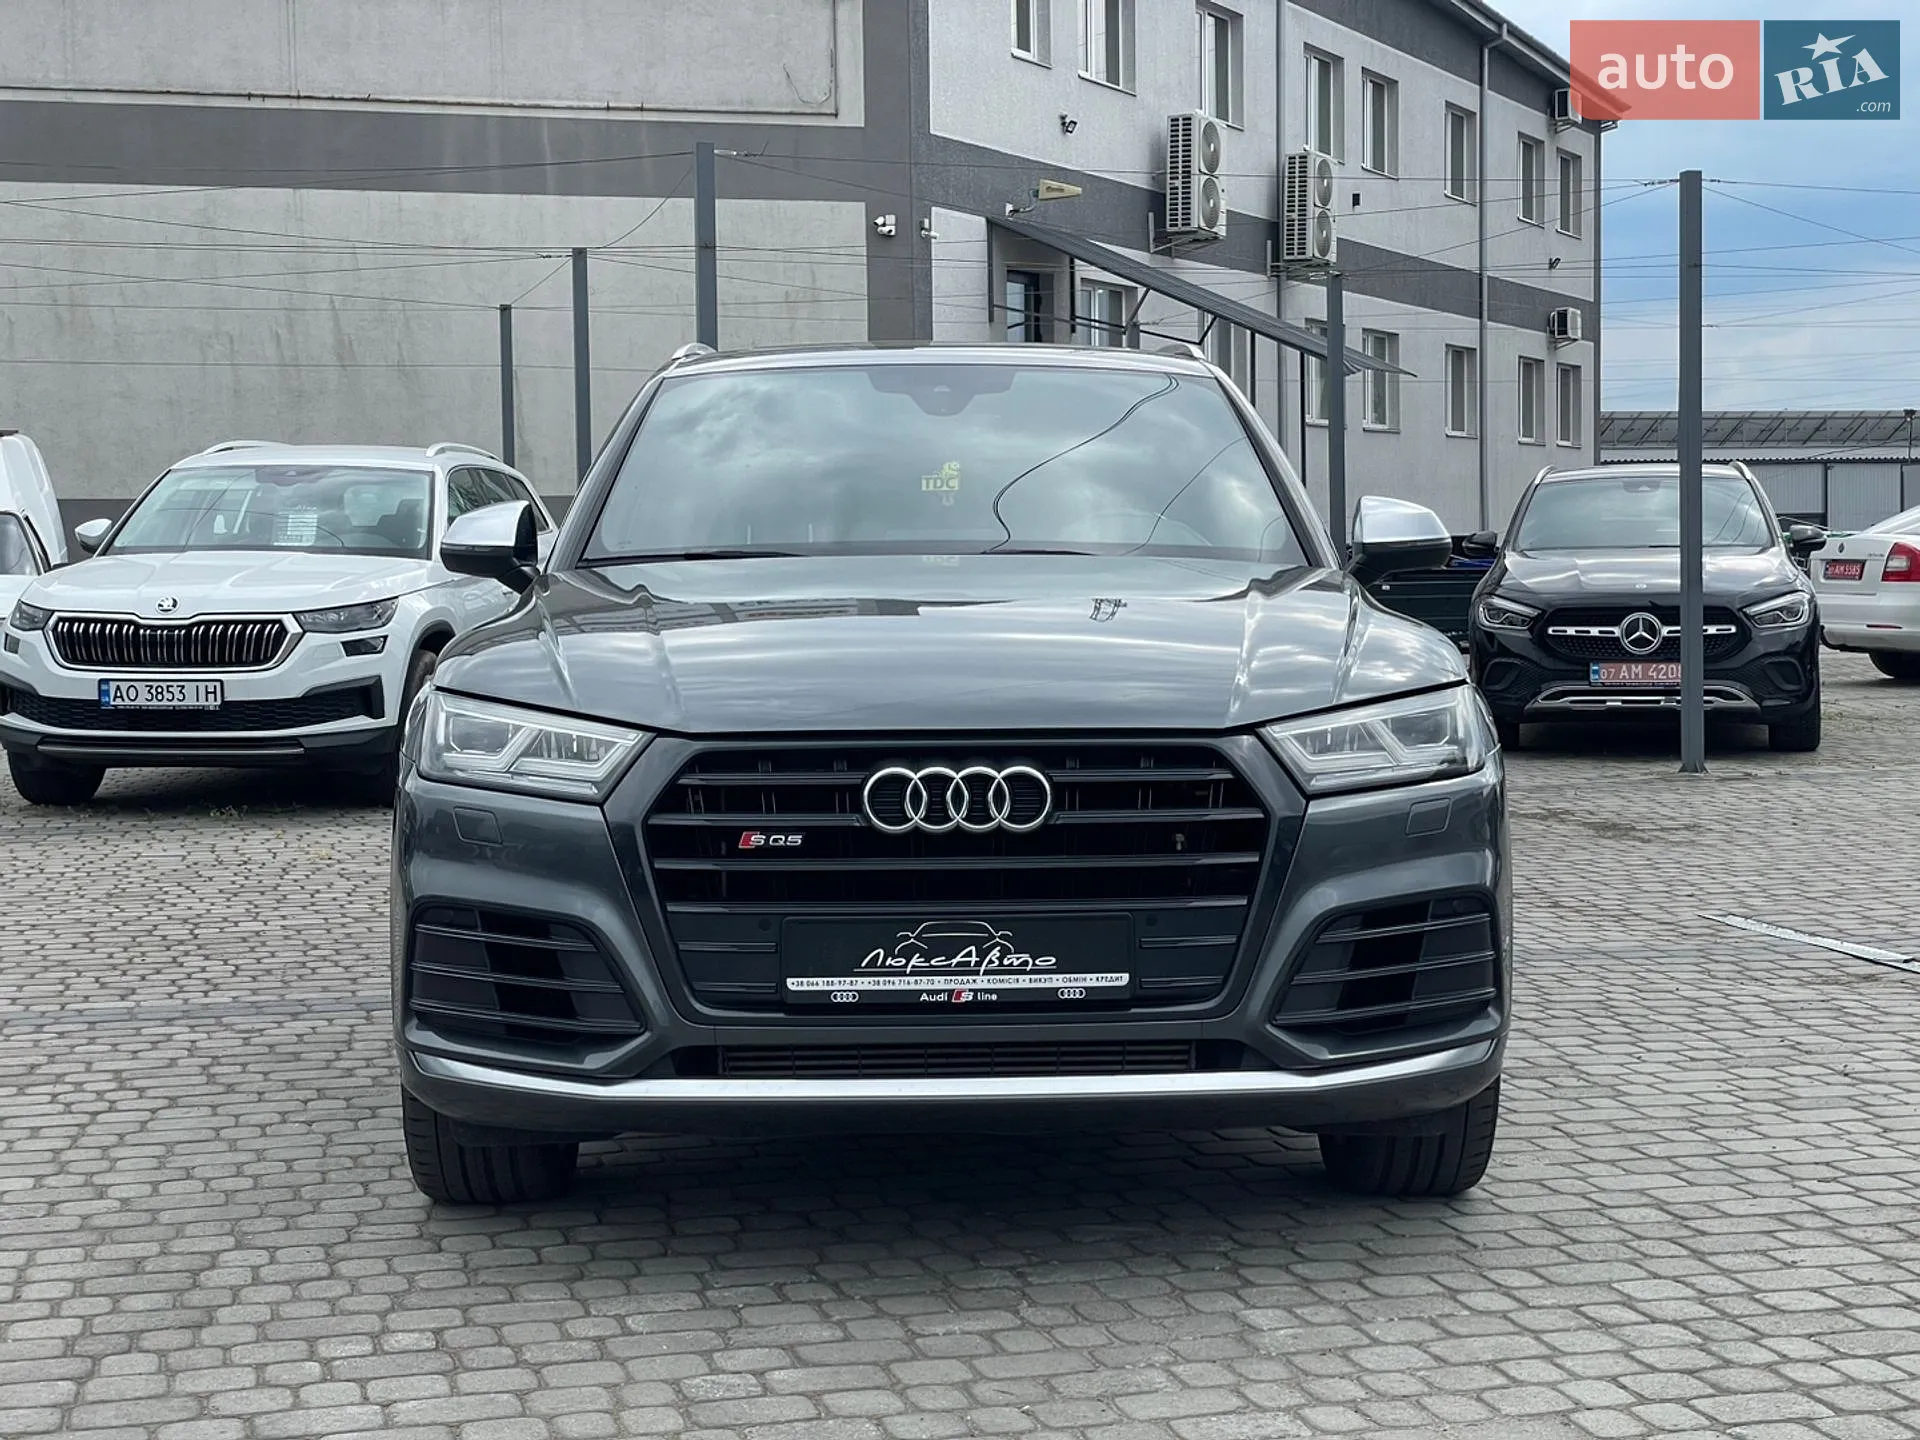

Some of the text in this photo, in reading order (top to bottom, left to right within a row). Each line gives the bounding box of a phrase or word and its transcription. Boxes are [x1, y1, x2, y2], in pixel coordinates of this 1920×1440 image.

[1601, 668, 1615, 679] 07
[1620, 664, 1642, 679] AM
[112, 684, 217, 702] AO 3853 IH
[944, 977, 978, 985] ПРОДАЖ
[920, 992, 948, 1001] Audi
[977, 991, 998, 1001] line
